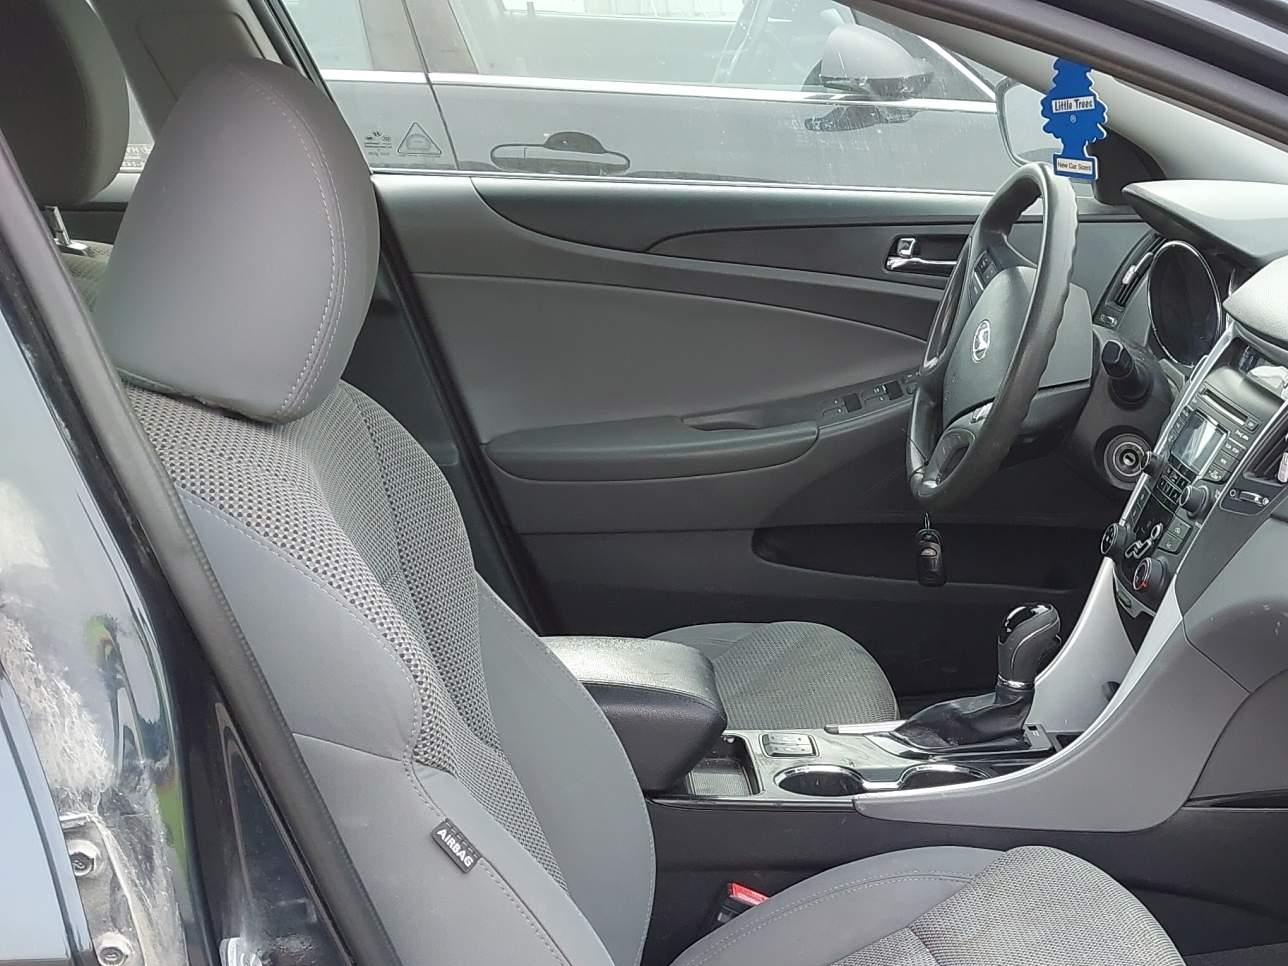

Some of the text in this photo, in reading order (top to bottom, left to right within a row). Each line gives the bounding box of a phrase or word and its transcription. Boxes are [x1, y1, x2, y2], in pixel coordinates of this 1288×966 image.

[1054, 99, 1094, 112] Little Trees
[1058, 160, 1068, 169] New
[1069, 162, 1078, 170] Car
[437, 829, 474, 868] AIRBAG
